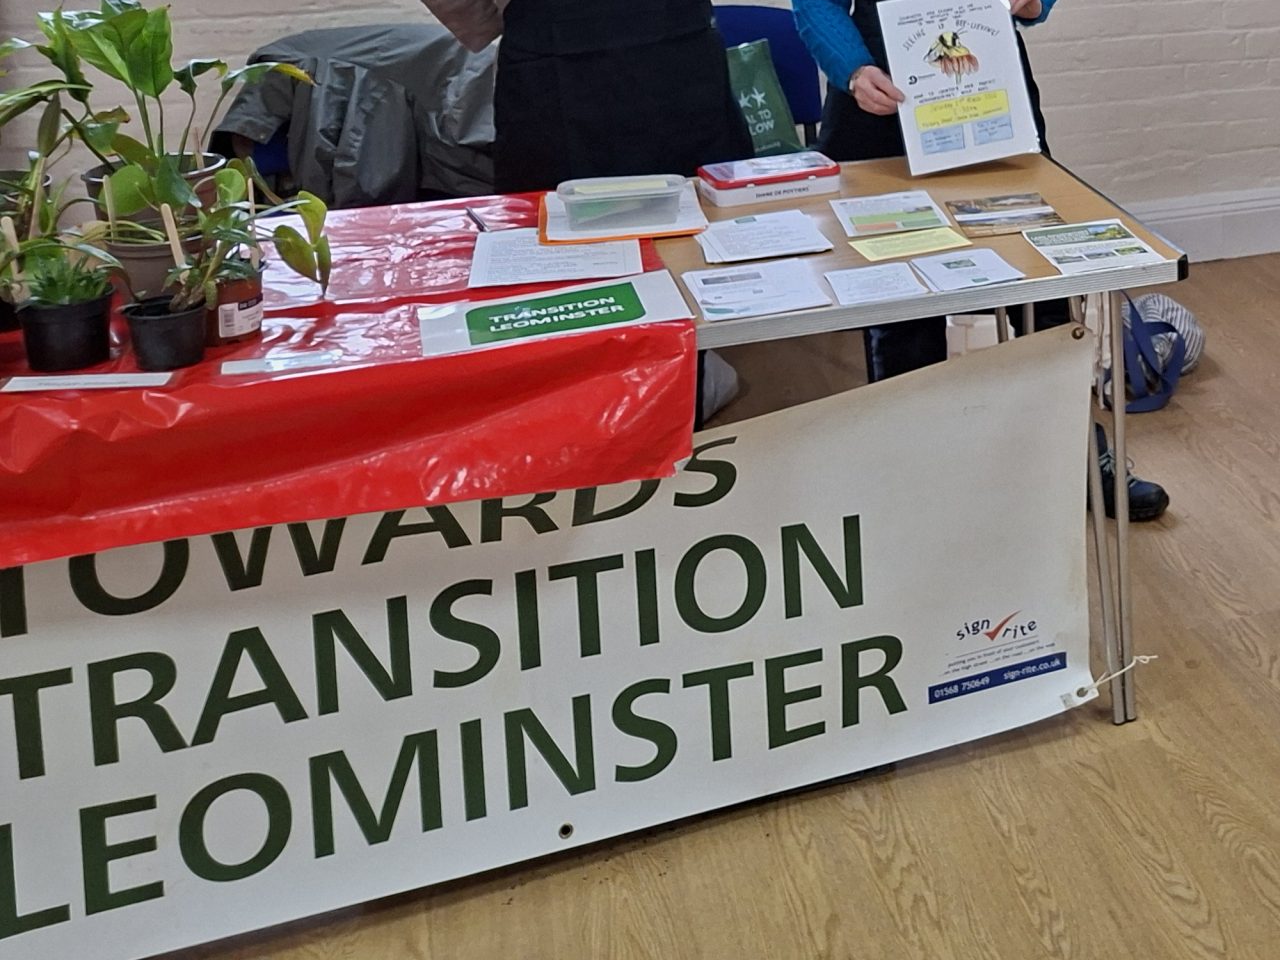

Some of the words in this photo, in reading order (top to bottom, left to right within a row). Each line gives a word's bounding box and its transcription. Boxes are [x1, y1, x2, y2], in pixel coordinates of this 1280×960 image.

[489, 297, 615, 323] TRANSITION
[489, 305, 625, 332] LEOMINSTER
[956, 618, 991, 640] sign
[1002, 620, 1038, 639] rite
[0, 513, 866, 781] TRANSITION
[933, 684, 960, 699] 01568
[960, 675, 991, 692] 750649
[1002, 657, 1062, 680] sign-rite.co.uk
[0, 635, 908, 940] LEOMINSTER
